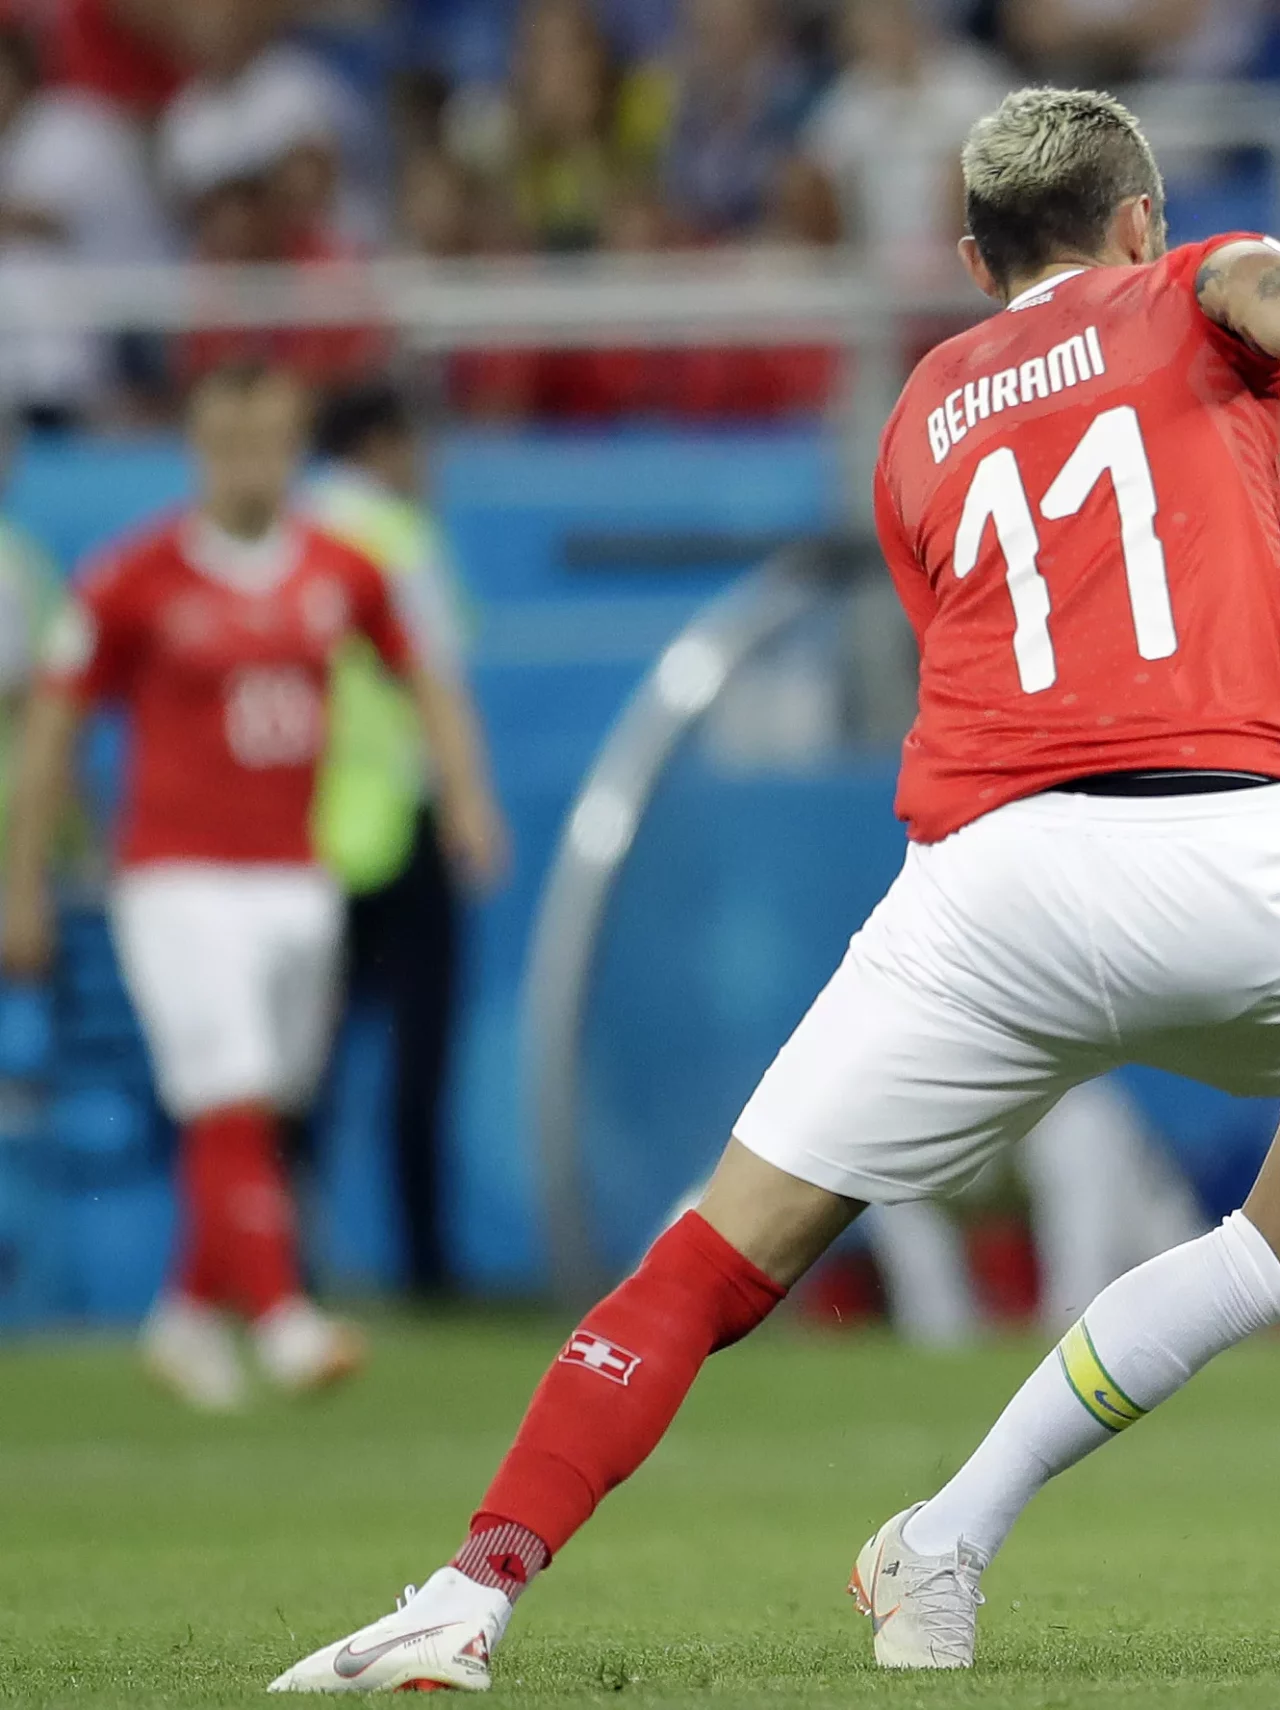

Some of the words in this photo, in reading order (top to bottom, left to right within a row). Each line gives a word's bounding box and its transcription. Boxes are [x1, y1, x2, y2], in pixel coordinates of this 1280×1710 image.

[926, 325, 1106, 464] BEHRAMI
[952, 403, 1178, 695] 11
[501, 1556, 517, 1579] L
